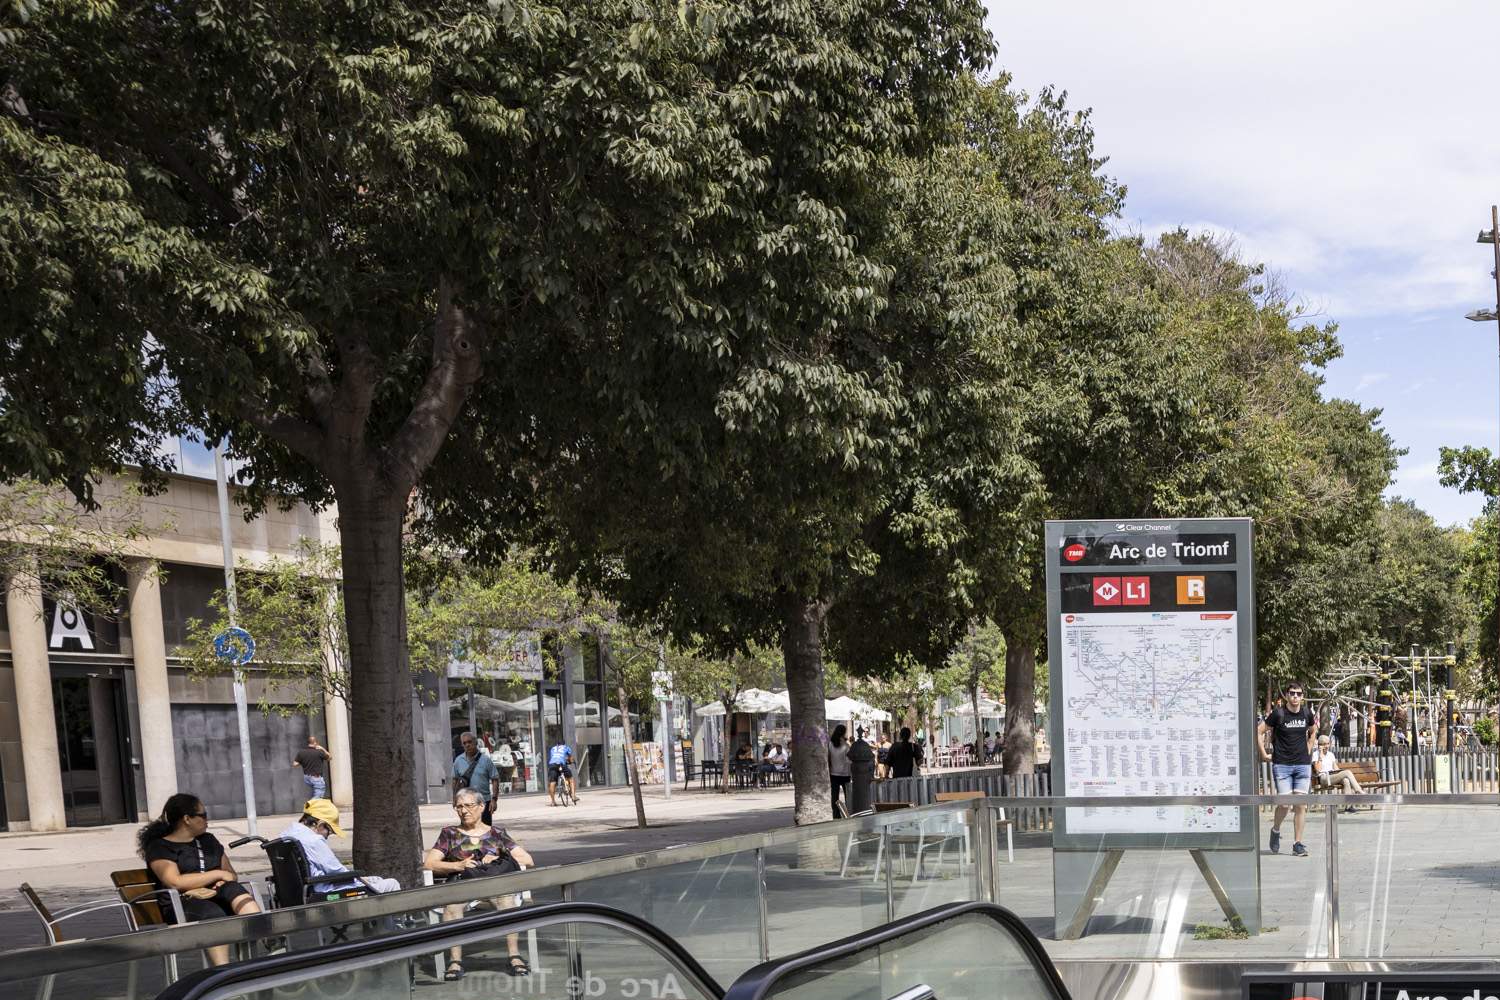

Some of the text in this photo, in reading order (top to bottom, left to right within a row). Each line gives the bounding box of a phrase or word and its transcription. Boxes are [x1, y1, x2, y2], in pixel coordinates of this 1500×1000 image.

[1109, 541, 1229, 559] Arc de Triomf
[1102, 587, 1112, 596] M
[1126, 582, 1146, 599] L1
[1187, 579, 1205, 597] R
